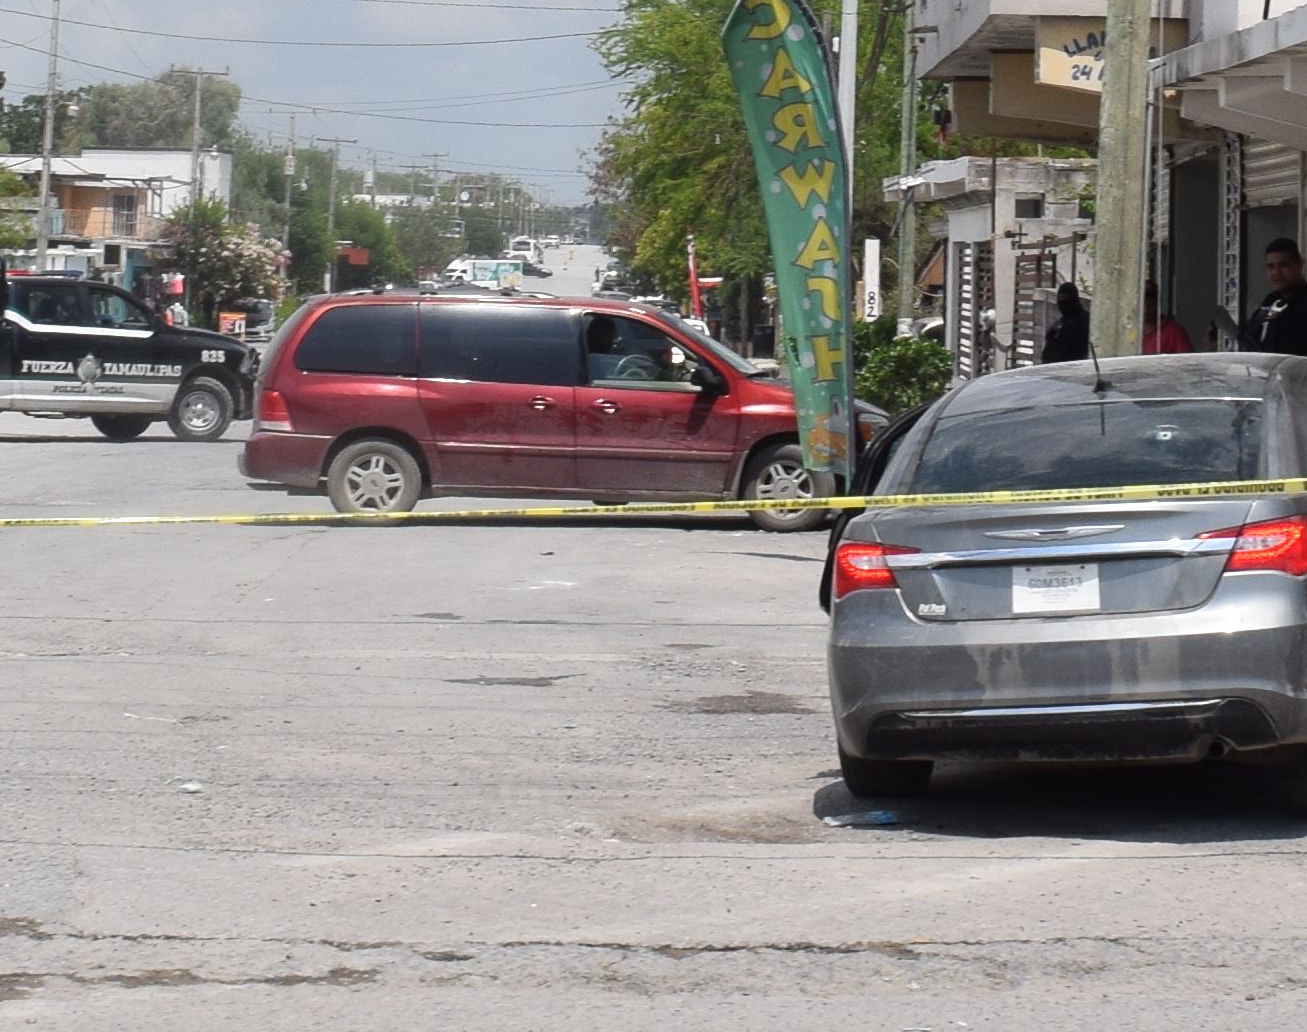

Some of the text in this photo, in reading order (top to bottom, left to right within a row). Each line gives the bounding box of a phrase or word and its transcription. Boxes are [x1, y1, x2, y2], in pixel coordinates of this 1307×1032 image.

[1071, 64, 1093, 81] 24
[201, 350, 226, 363] 835
[21, 360, 183, 377] FUERZA TAMAULIPAS
